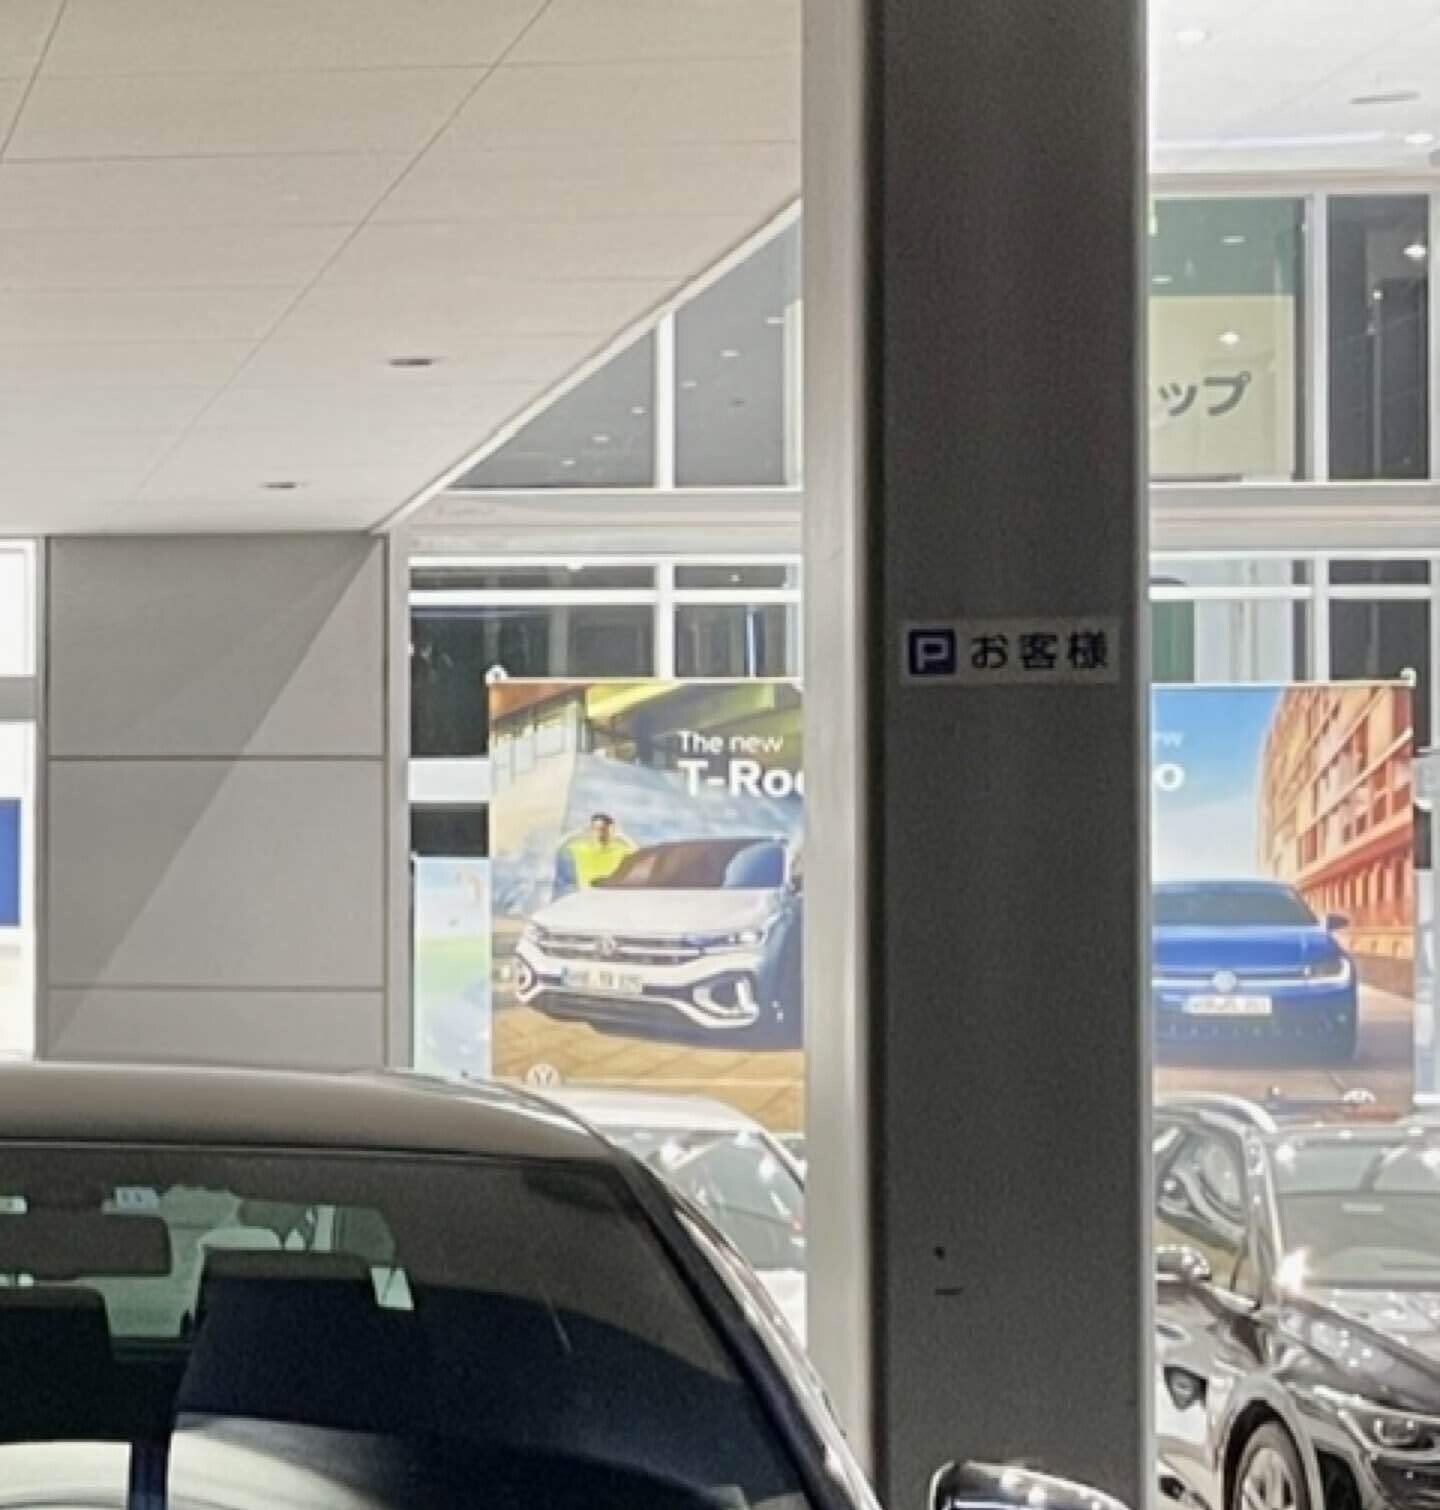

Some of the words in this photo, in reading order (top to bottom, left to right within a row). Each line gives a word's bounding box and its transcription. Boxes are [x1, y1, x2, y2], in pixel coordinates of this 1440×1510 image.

[1157, 369, 1252, 417] ップ
[970, 630, 1108, 670] お客様
[678, 729, 724, 754] The
[730, 735, 784, 753] new
